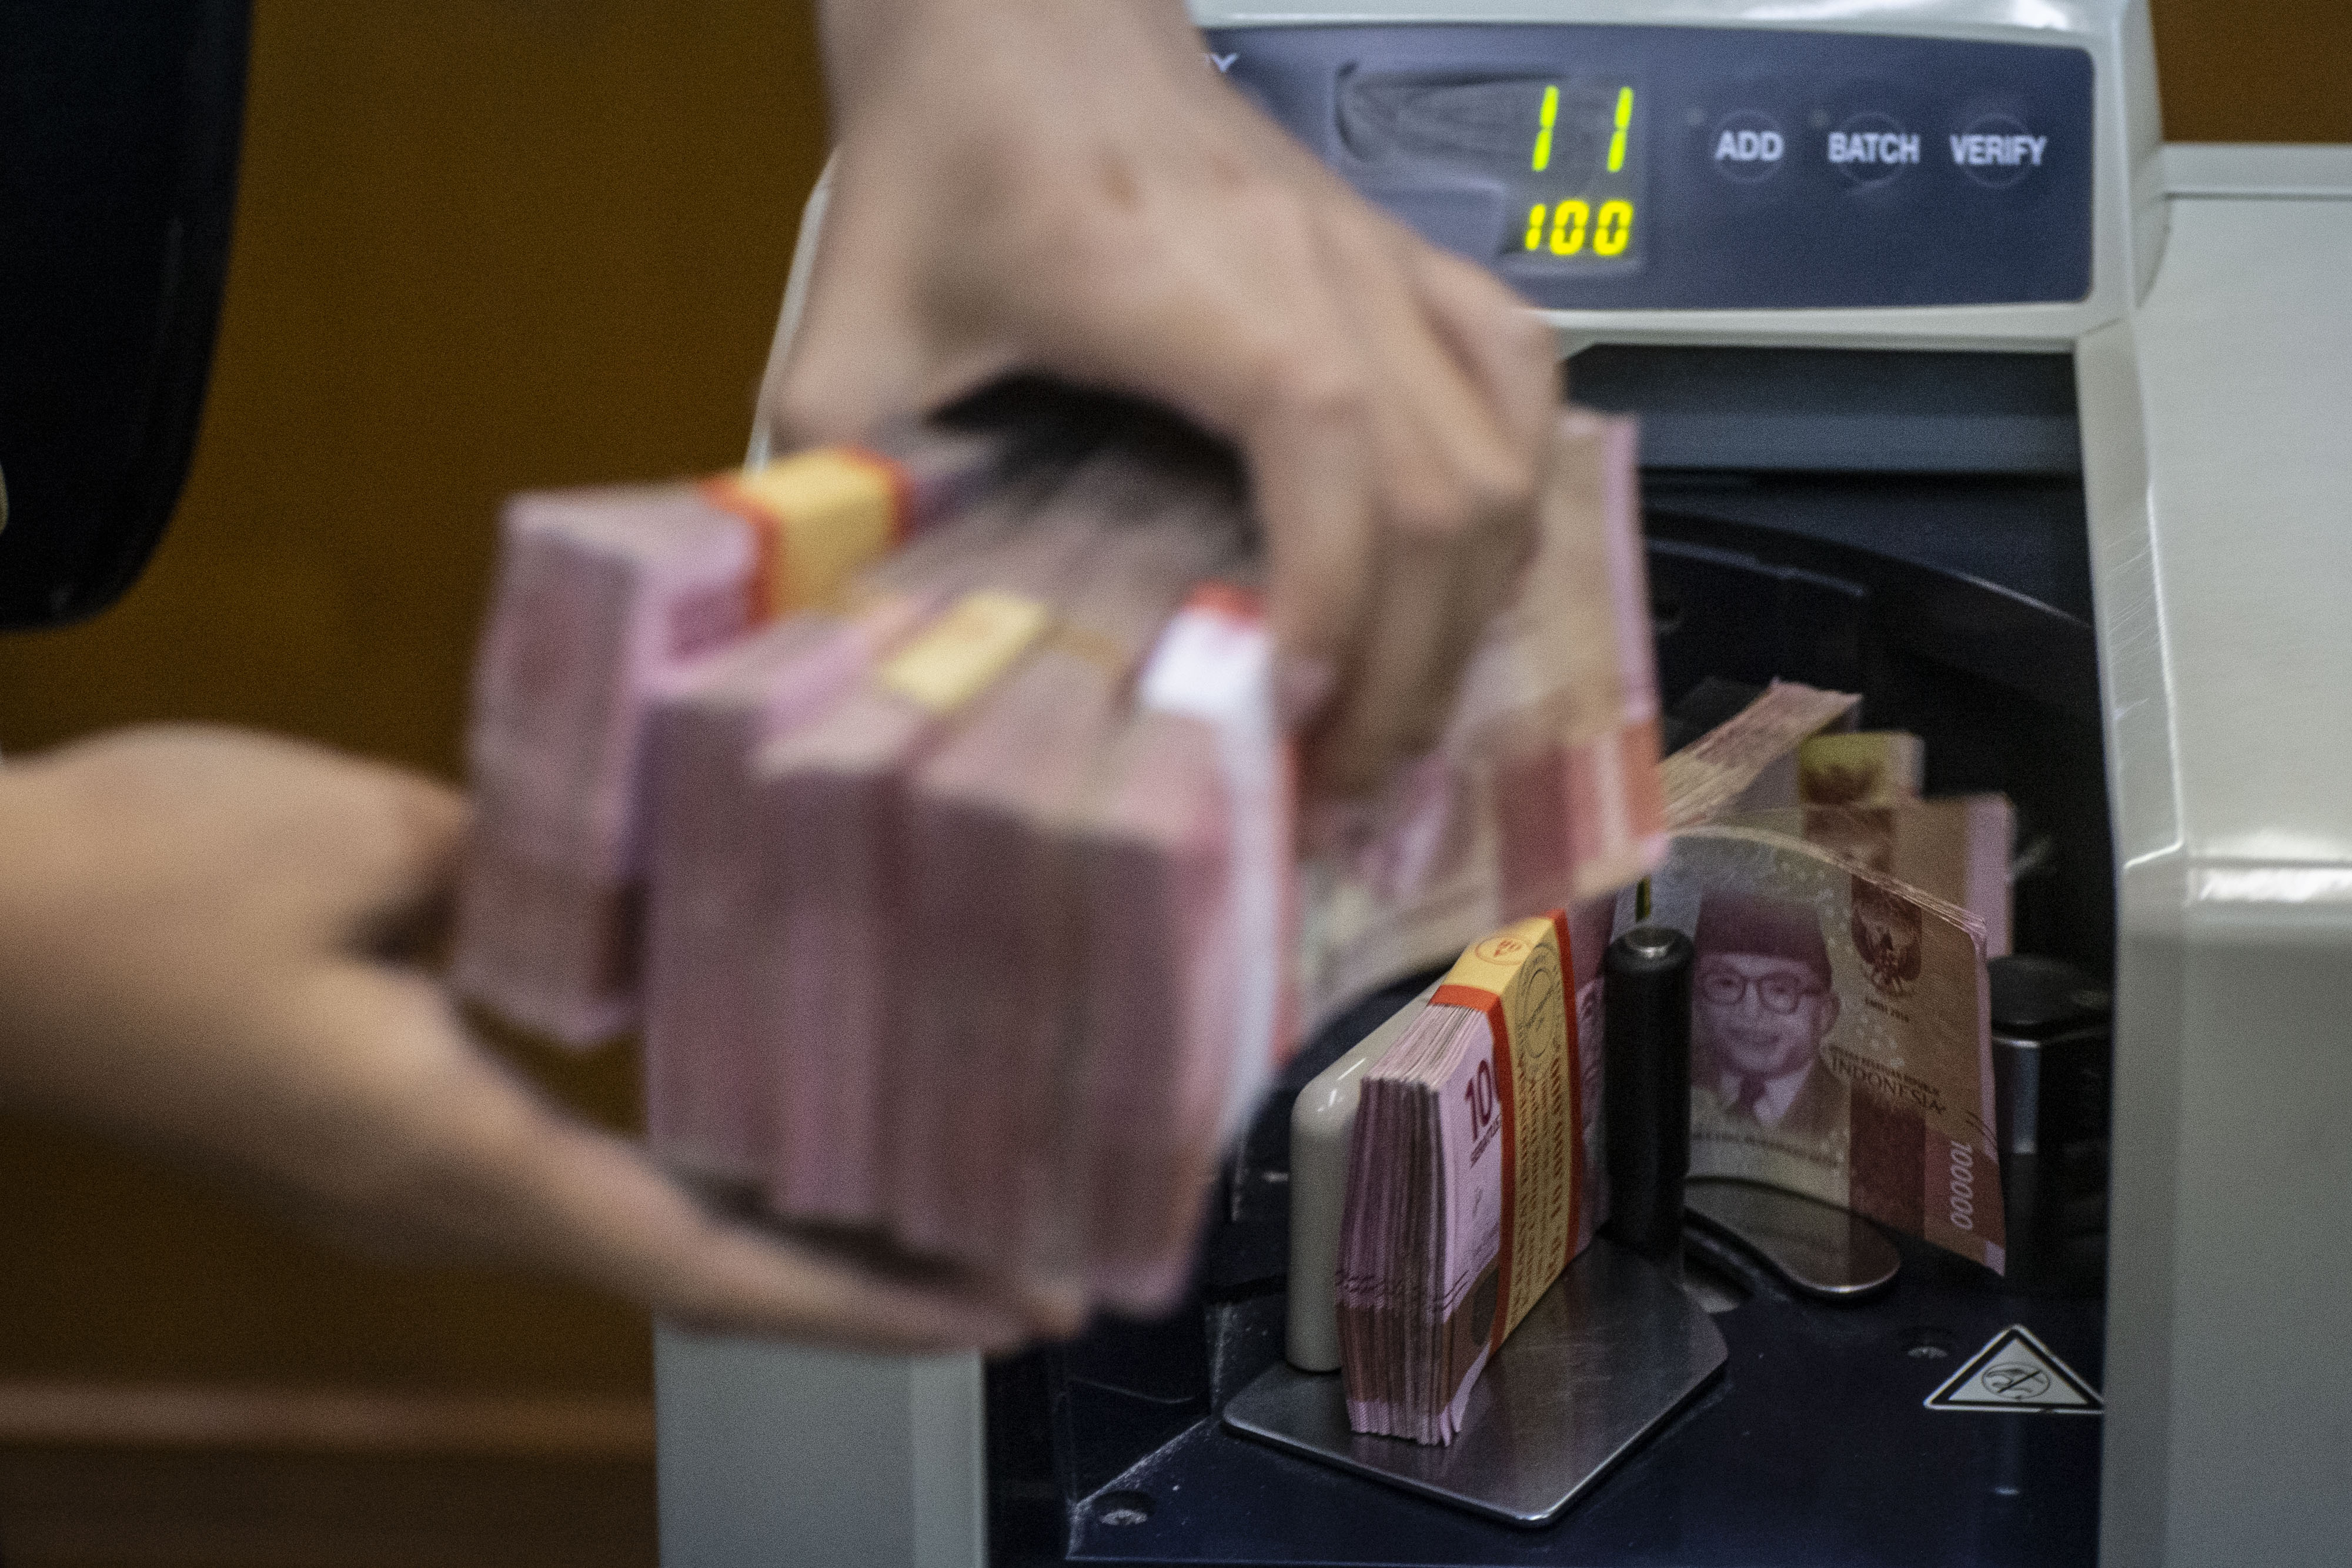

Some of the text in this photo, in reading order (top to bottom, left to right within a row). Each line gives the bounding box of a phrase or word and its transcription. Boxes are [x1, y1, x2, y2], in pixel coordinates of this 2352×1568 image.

[1532, 84, 1634, 172] 11
[1715, 129, 1784, 162] ADD
[1827, 131, 1920, 165] BATCH
[1949, 133, 2048, 167] VERIFY
[1525, 199, 1634, 256] 100
[1831, 1056, 1947, 1115] INDONESIA
[1949, 1141, 1975, 1231] 100000
